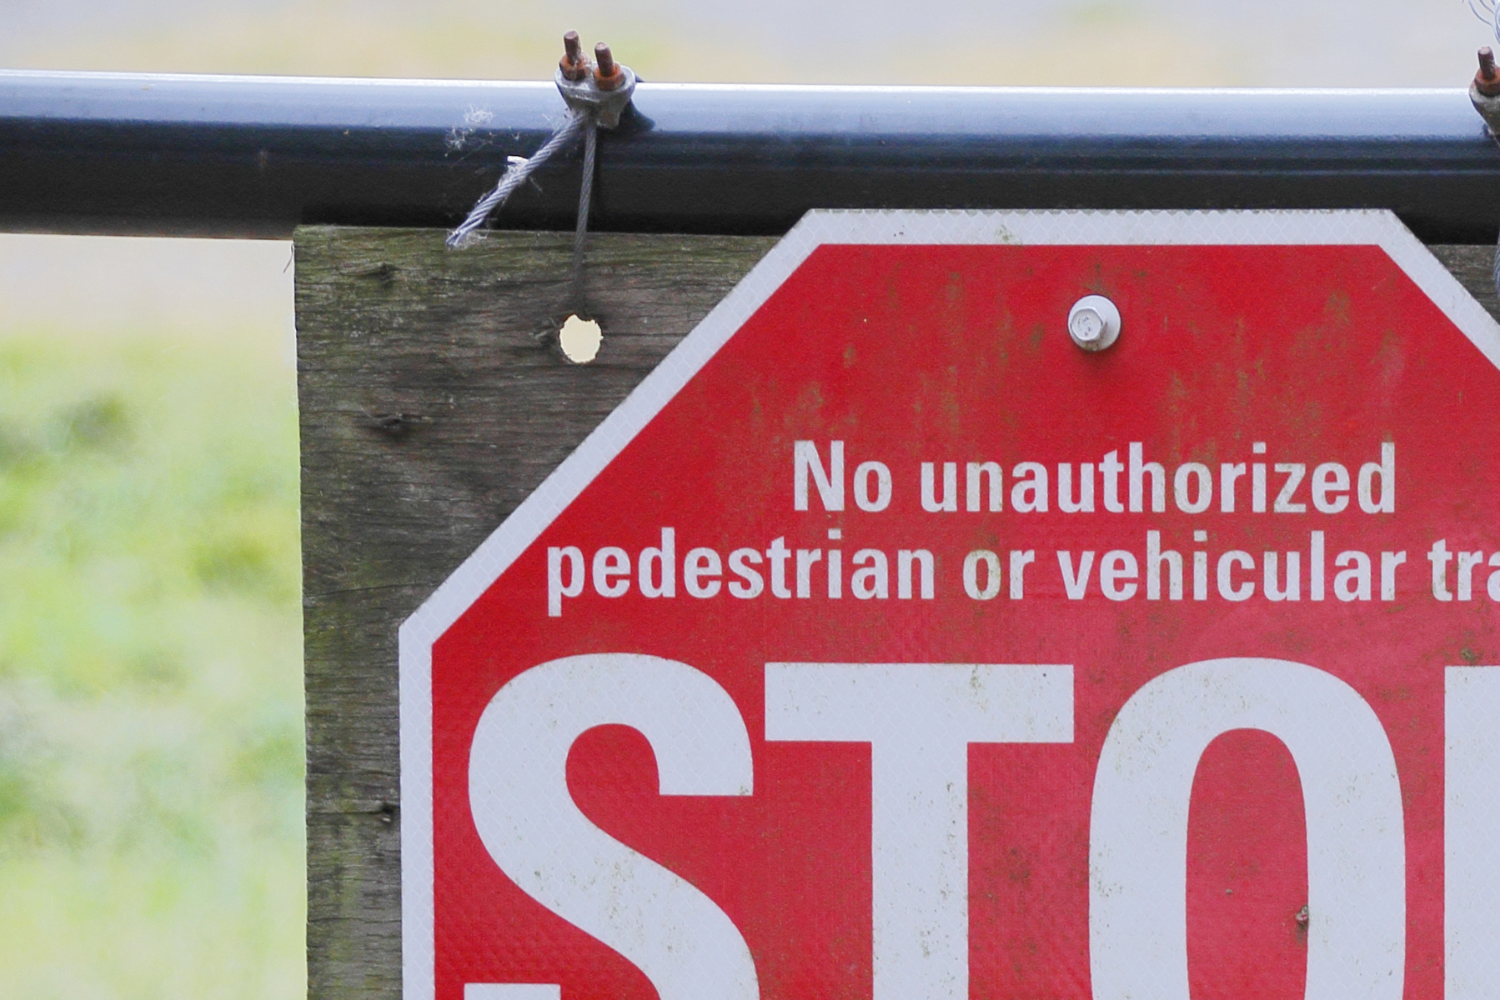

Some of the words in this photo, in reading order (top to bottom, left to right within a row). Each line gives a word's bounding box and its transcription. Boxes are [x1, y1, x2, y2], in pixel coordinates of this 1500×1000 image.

[794, 440, 893, 513] No
[921, 441, 1396, 515] unauthorized
[547, 526, 936, 618] pedestrian
[962, 549, 1036, 601] or
[1056, 529, 1407, 603] vehicular
